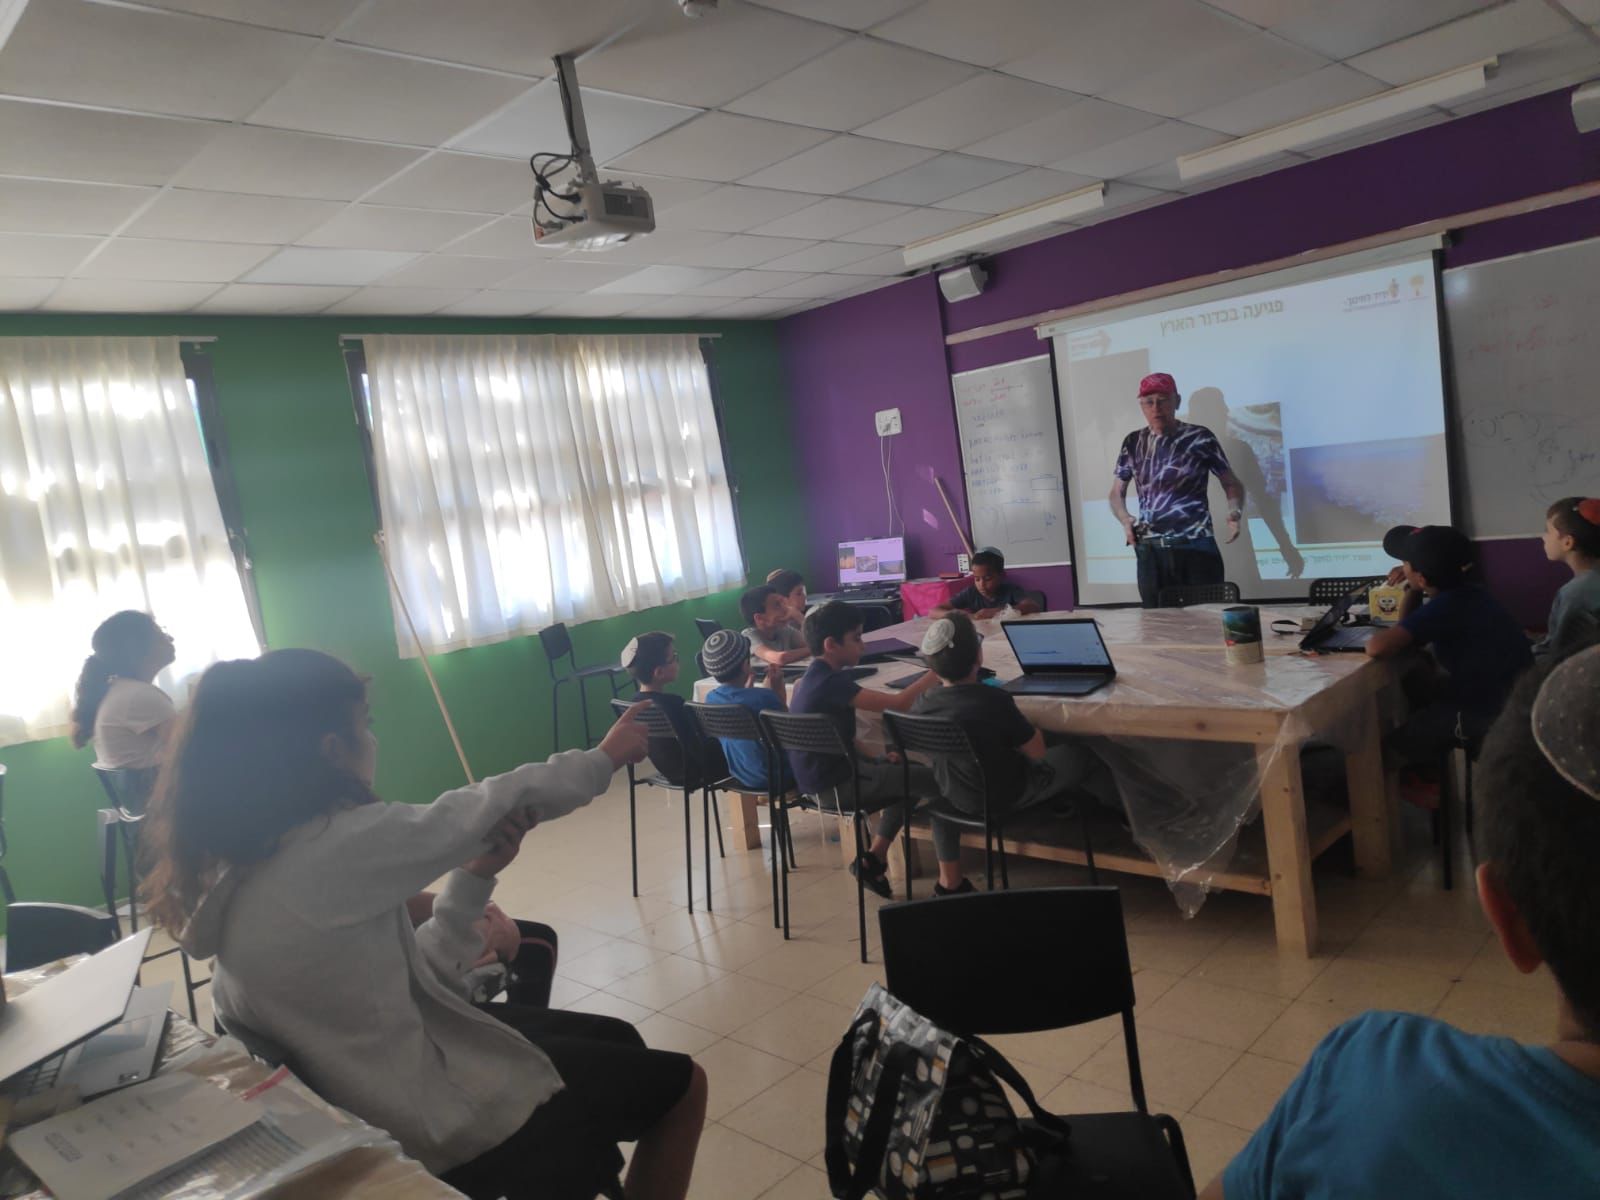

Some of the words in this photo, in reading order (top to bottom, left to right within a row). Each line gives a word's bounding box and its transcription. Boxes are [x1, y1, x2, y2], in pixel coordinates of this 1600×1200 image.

[1198, 308, 1240, 327] בכדור
[1242, 300, 1285, 319] פגיעה
[1160, 316, 1195, 338] הארץ
